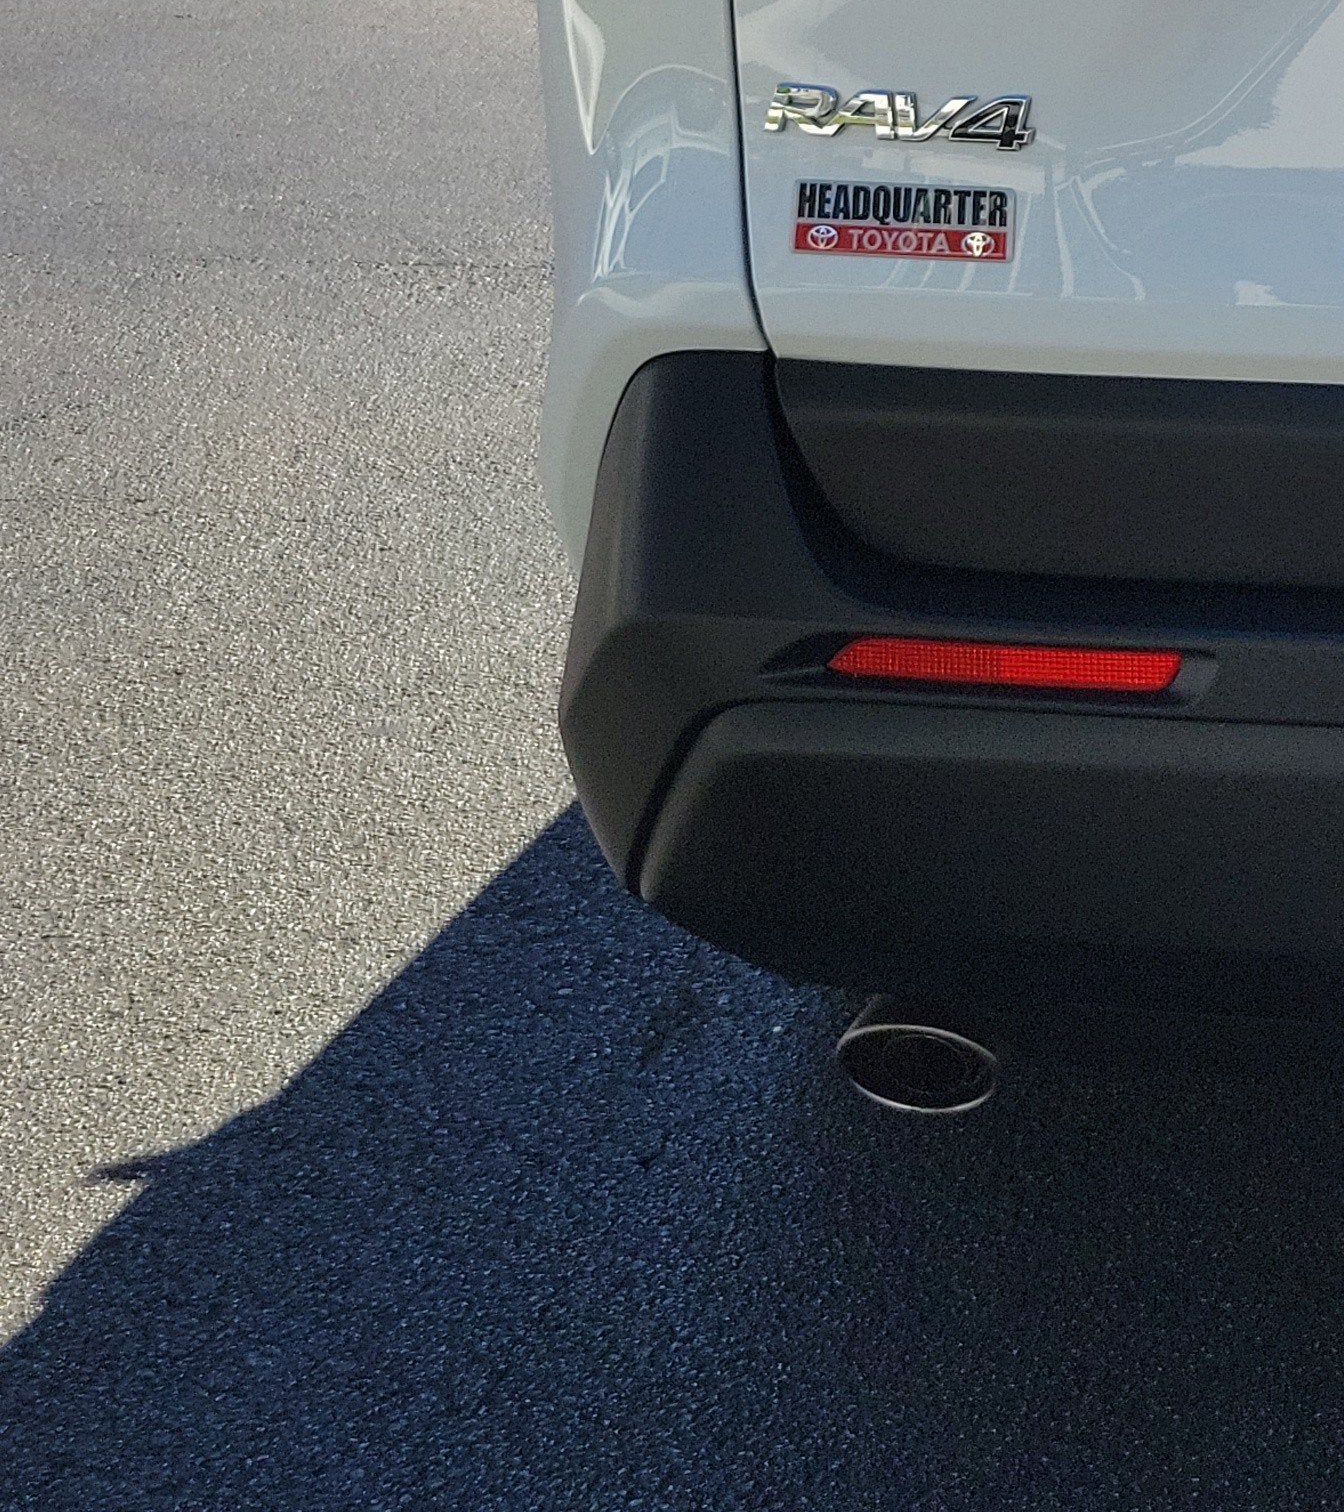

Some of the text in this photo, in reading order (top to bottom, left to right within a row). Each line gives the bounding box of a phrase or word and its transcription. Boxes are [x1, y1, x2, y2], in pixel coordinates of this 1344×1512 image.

[763, 81, 1037, 151] RAV4
[797, 182, 1009, 228] HEADQUARTER
[848, 228, 950, 254] TOYOTA
